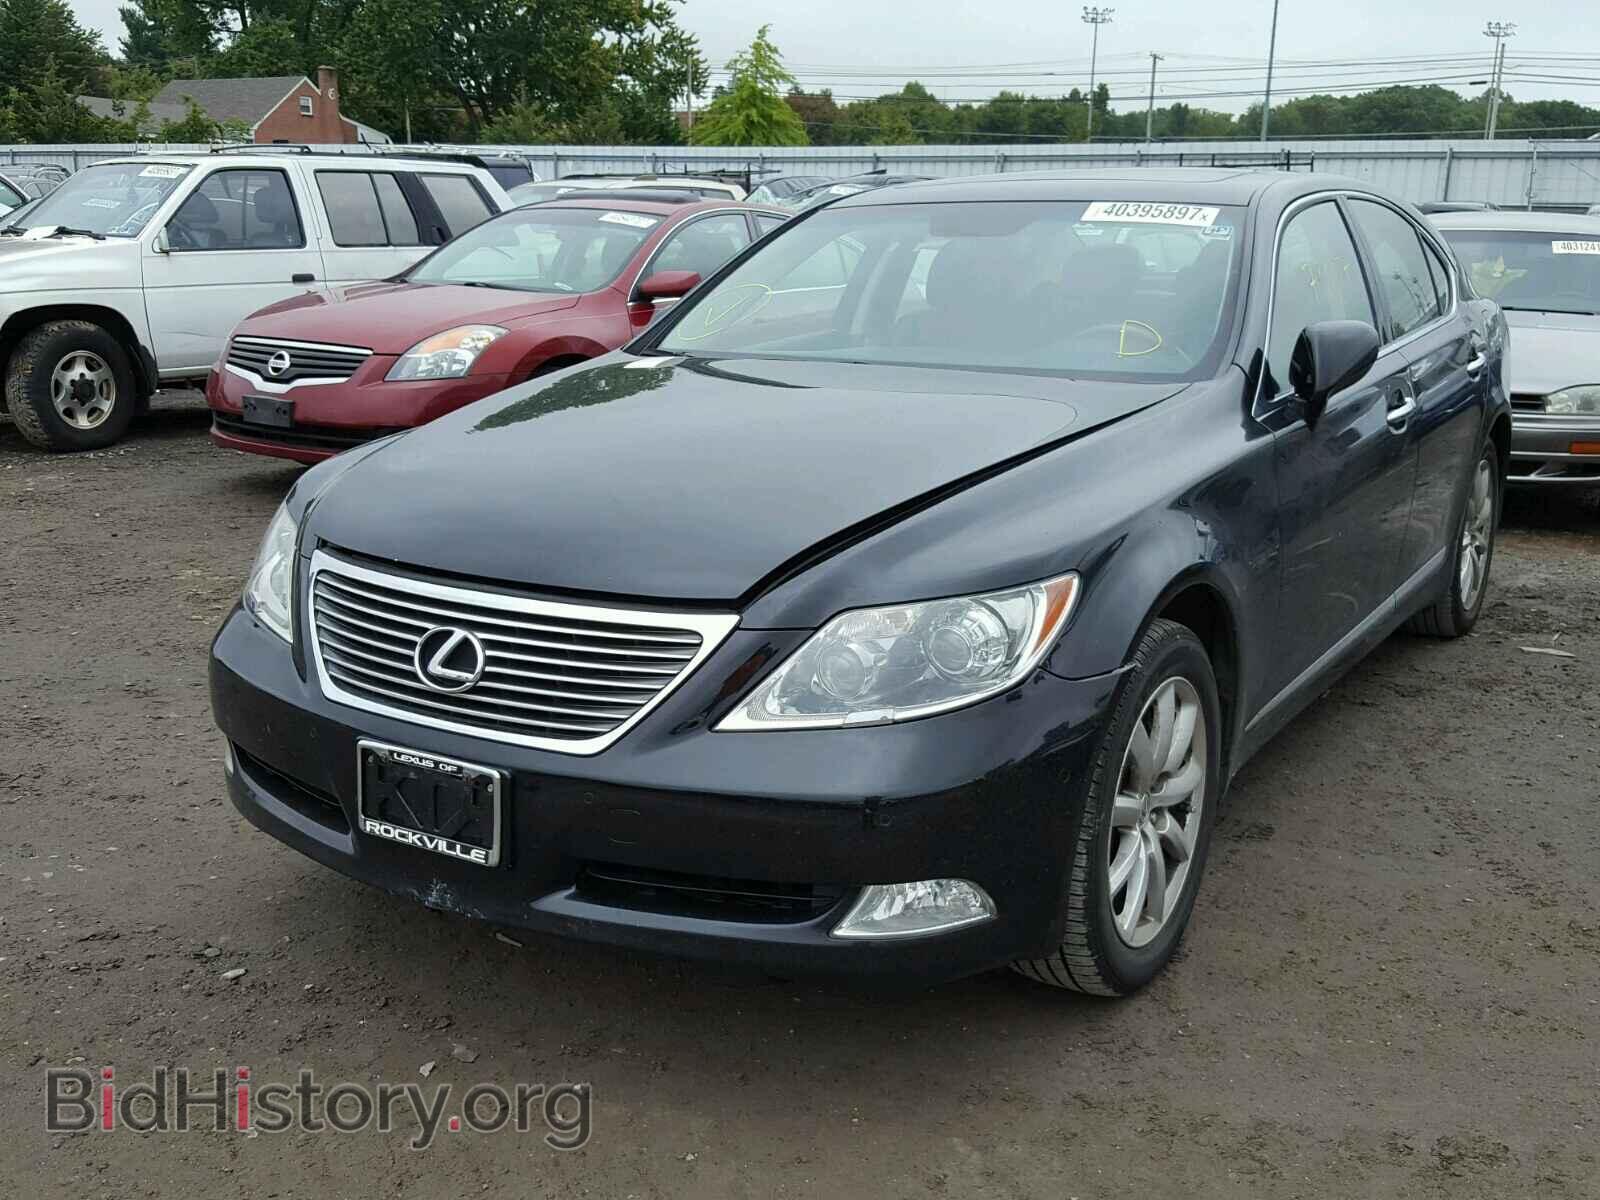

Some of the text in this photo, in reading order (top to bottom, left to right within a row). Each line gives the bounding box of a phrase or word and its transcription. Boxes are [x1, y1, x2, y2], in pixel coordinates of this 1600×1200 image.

[393, 752, 458, 772] LEXUS OF
[365, 820, 487, 863] ROCKVILLE
